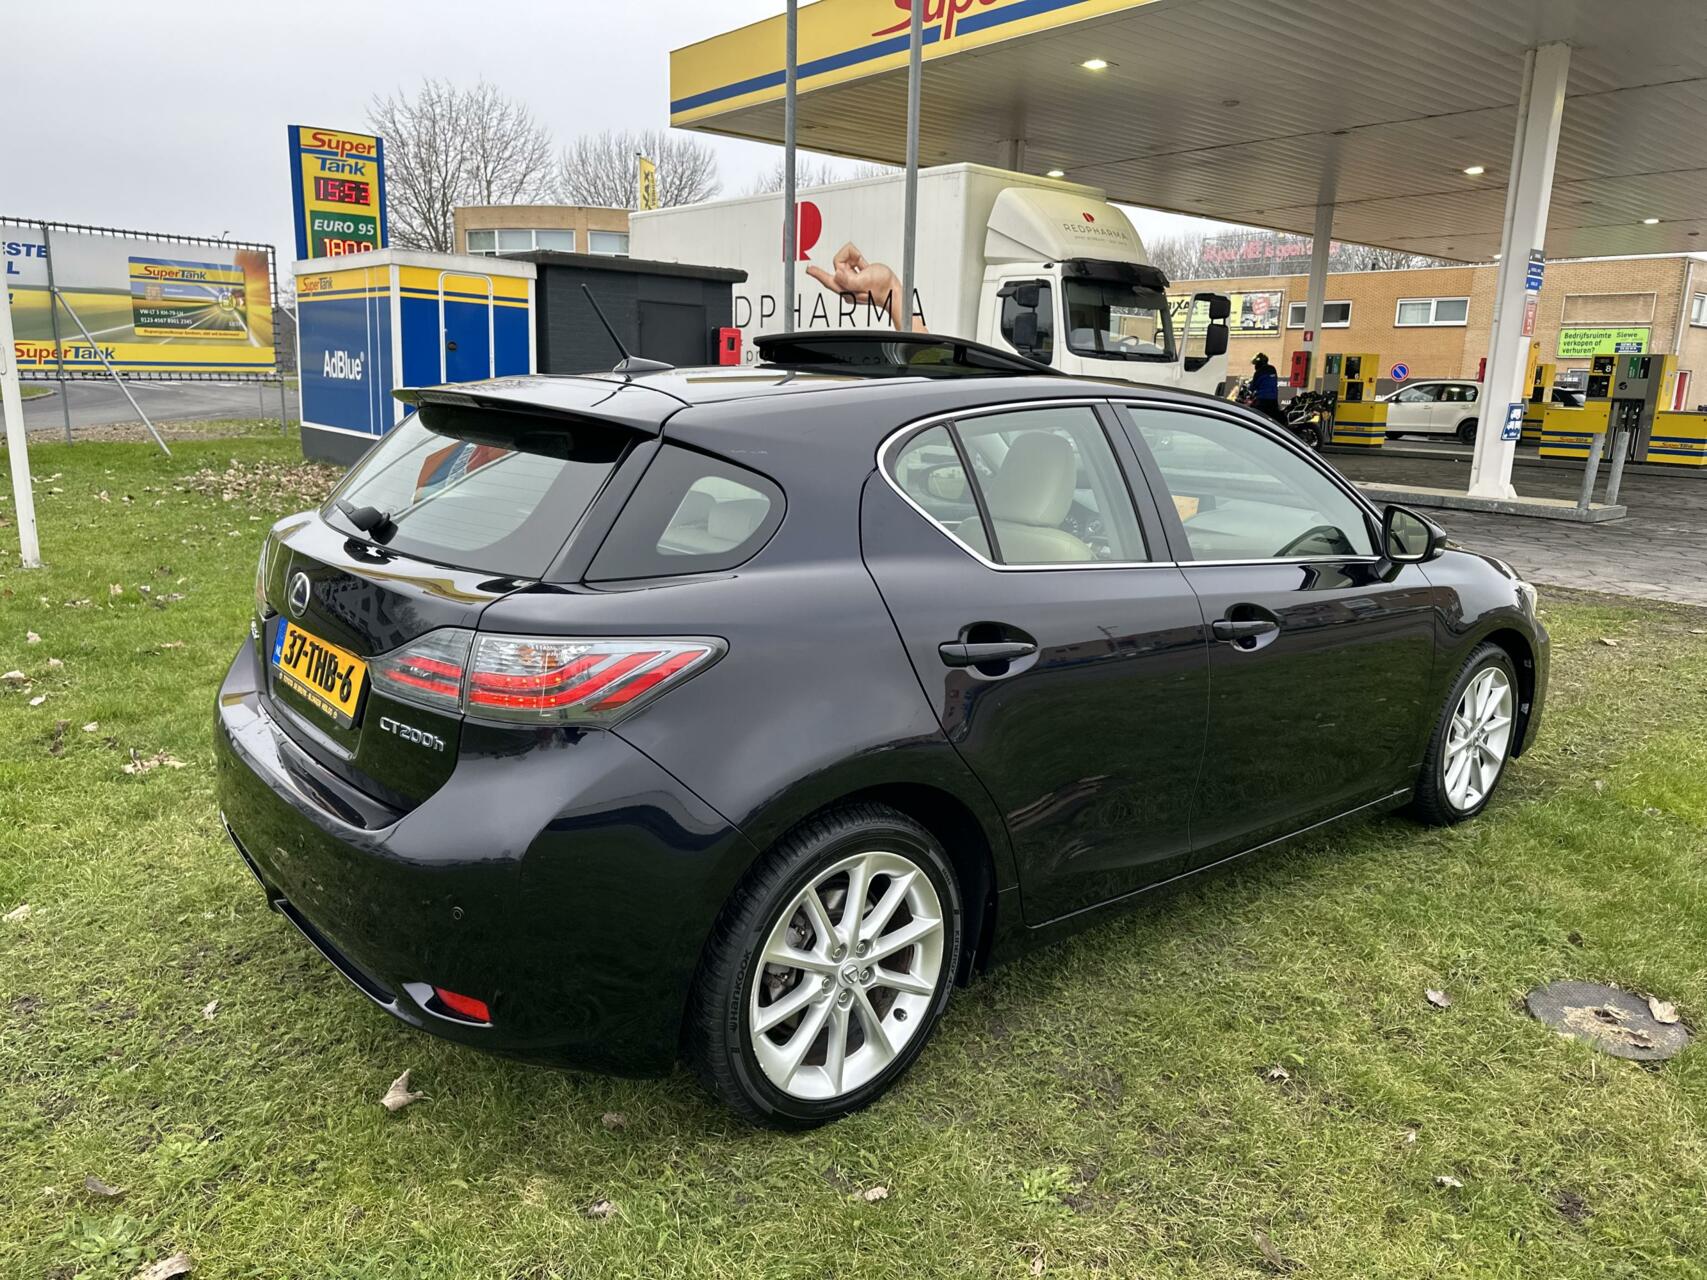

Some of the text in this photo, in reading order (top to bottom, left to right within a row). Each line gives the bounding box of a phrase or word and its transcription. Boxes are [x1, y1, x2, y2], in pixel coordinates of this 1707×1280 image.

[301, 132, 375, 157] Super
[313, 156, 365, 176] Tank
[320, 179, 370, 204] 15:53
[314, 219, 374, 235] EURO 95
[1063, 223, 1128, 240] REDPHARMA
[139, 265, 207, 281] SuperTank
[1564, 332, 1612, 340] Bedrijfsruimte
[323, 350, 362, 380] AdBlue
[283, 630, 355, 703] 37-THB-6
